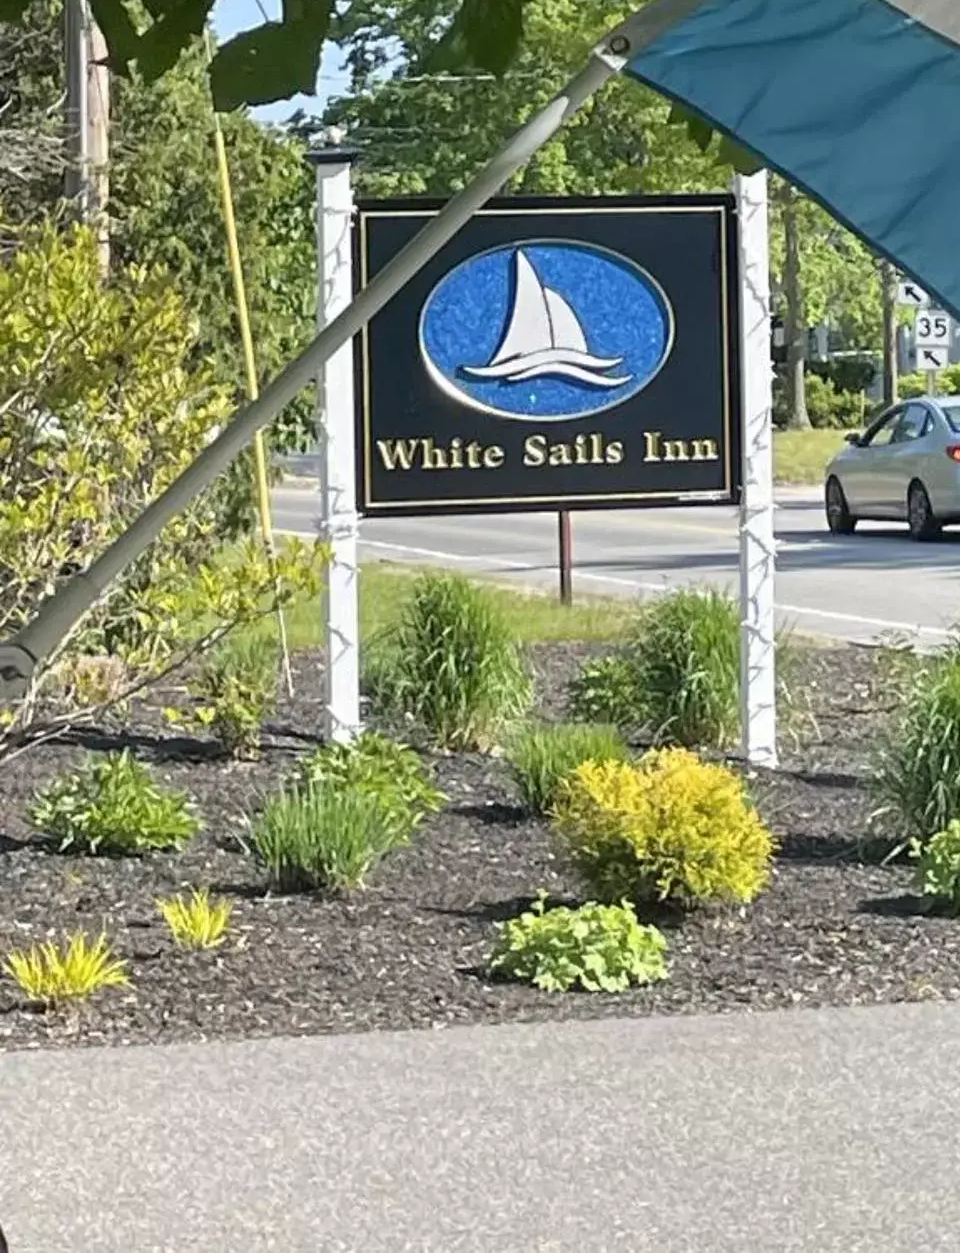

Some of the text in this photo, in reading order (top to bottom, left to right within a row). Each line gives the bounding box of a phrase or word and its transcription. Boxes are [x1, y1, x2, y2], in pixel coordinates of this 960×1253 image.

[919, 316, 947, 338] 35
[376, 431, 720, 471] White Sails Inn
